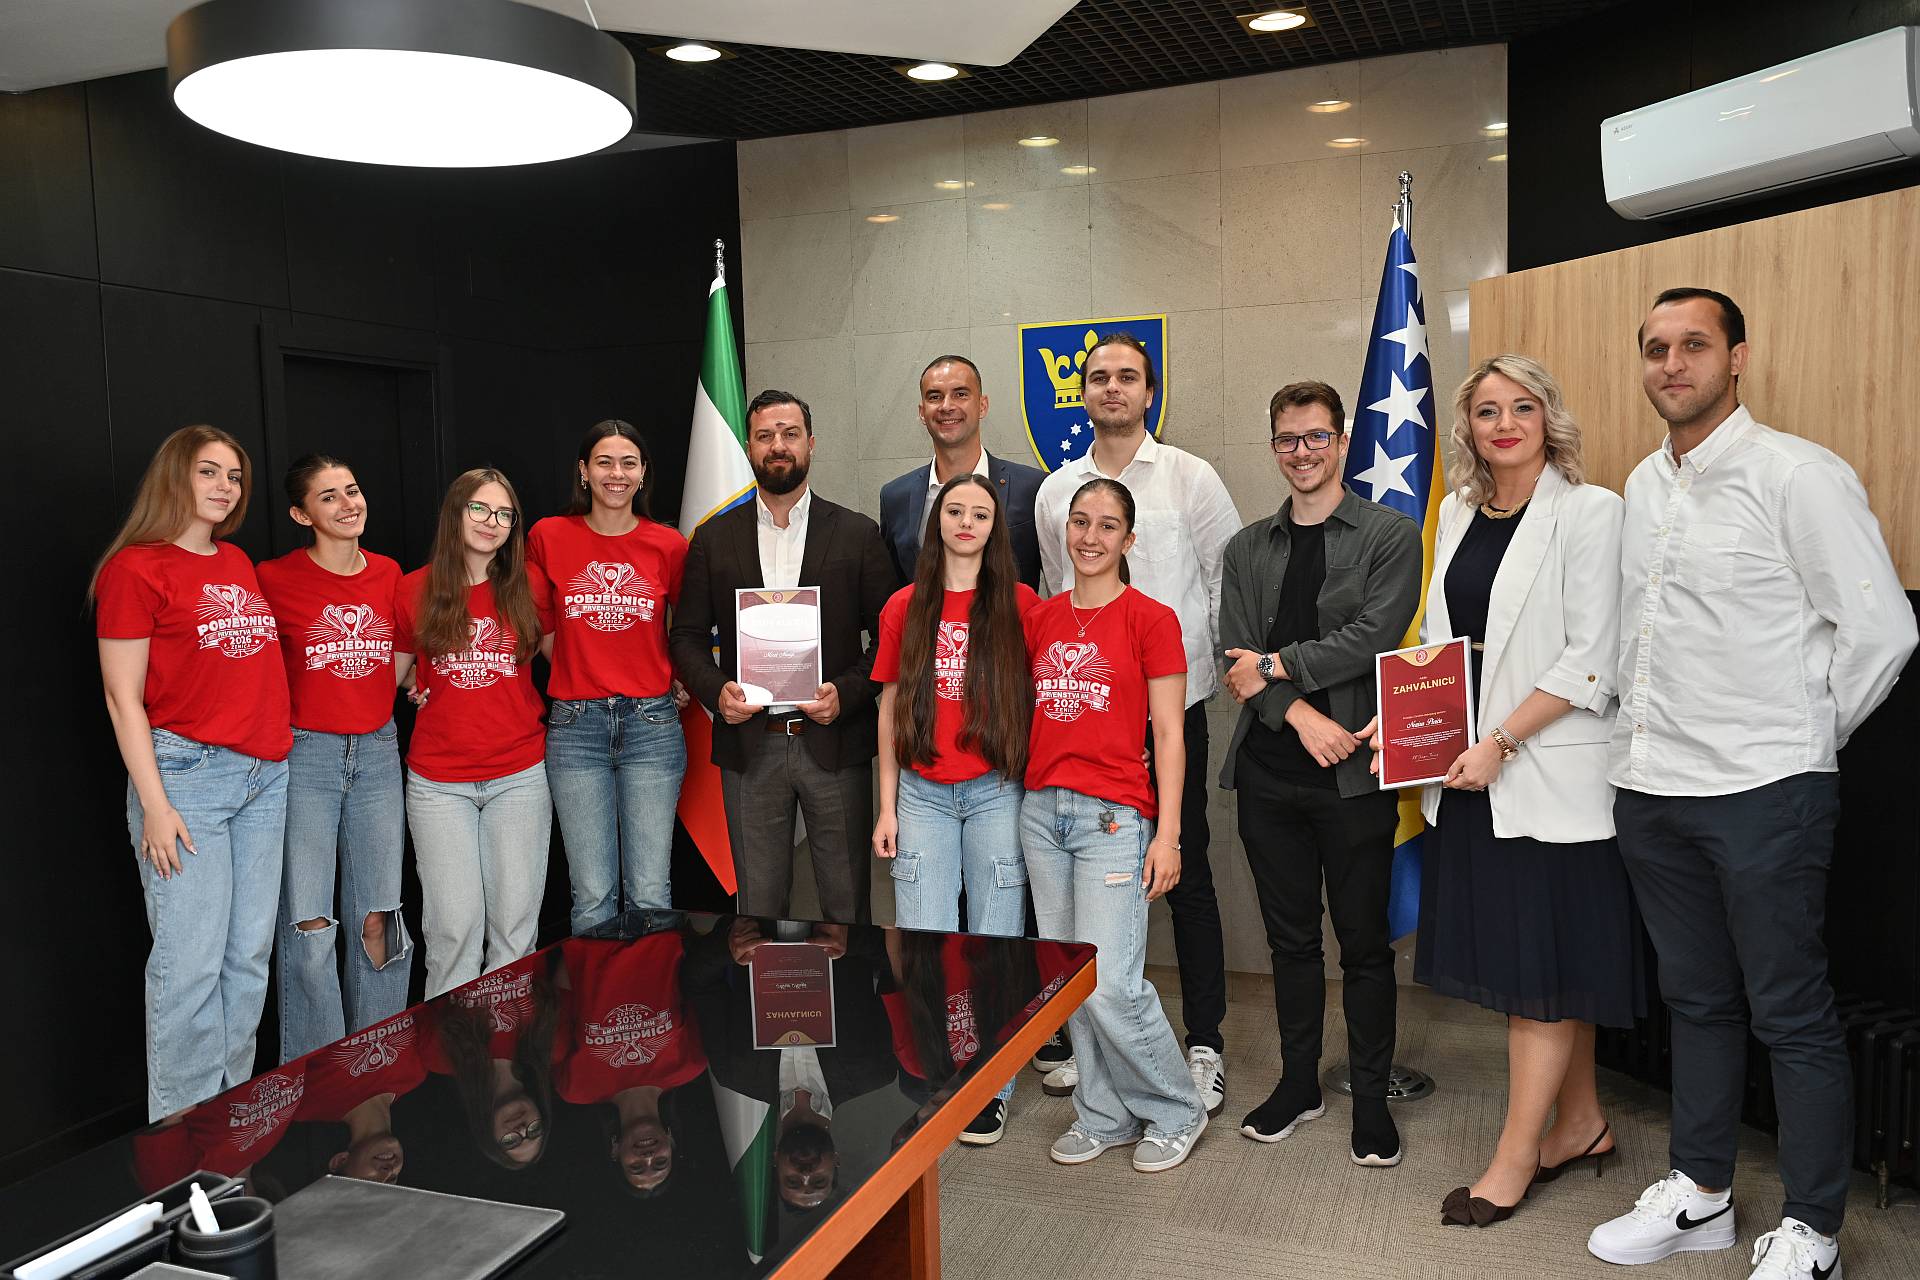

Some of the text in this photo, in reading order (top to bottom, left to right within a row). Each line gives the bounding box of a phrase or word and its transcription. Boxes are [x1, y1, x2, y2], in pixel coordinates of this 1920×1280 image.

[565, 593, 655, 610] POBJEDNICE
[582, 605, 624, 613] PRVENSTVA
[597, 612, 625, 620] 2026
[197, 615, 276, 637] POBJEDNICE
[230, 636, 252, 645] 2026
[326, 651, 367, 660] PRVENSTVA
[341, 658, 368, 667] 2026
[460, 669, 488, 678] 2026
[1393, 675, 1455, 695] ZAHVALNICU
[1053, 699, 1080, 708] 2026
